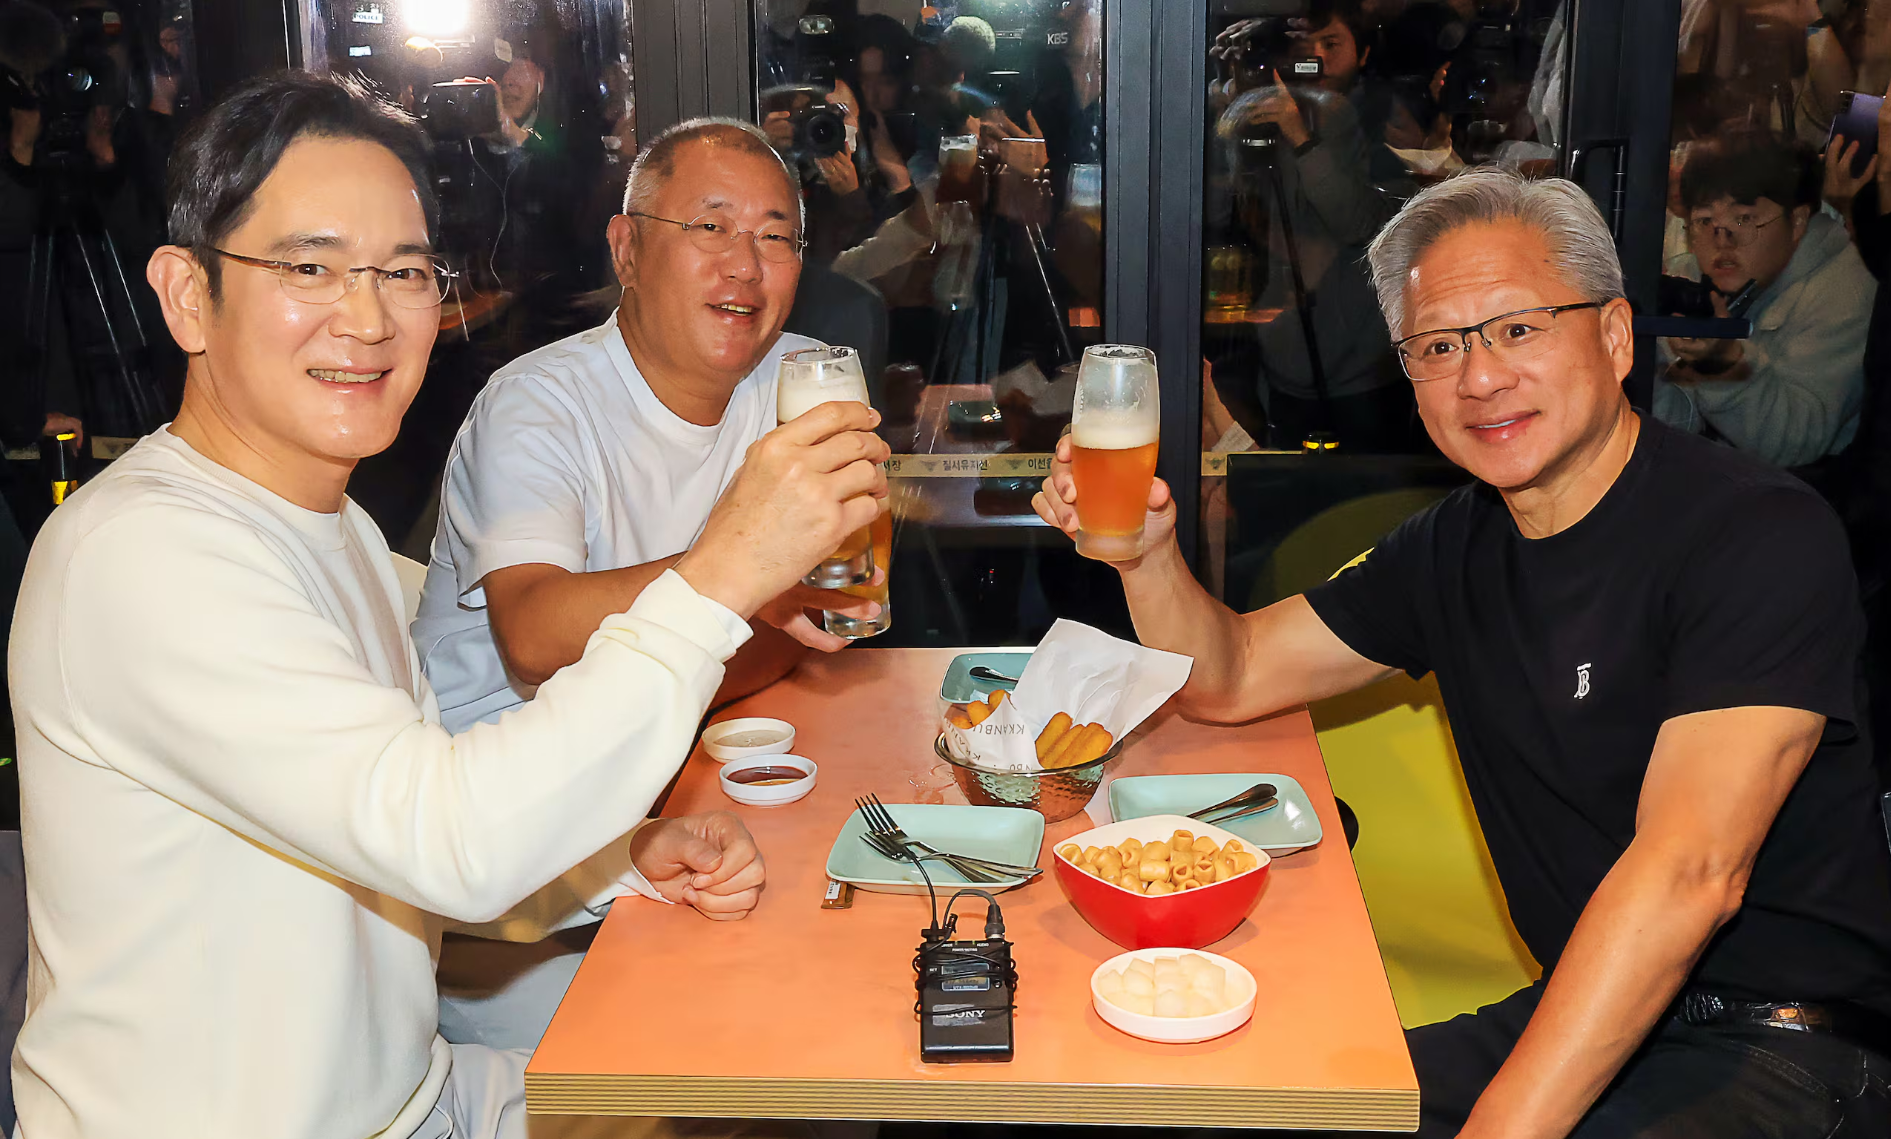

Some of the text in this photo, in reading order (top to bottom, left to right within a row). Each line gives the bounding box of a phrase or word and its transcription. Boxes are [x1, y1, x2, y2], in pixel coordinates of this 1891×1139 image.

[1047, 32, 1068, 45] KBS
[942, 459, 988, 471] 질서유지선
[973, 724, 1025, 735] KKANBU
